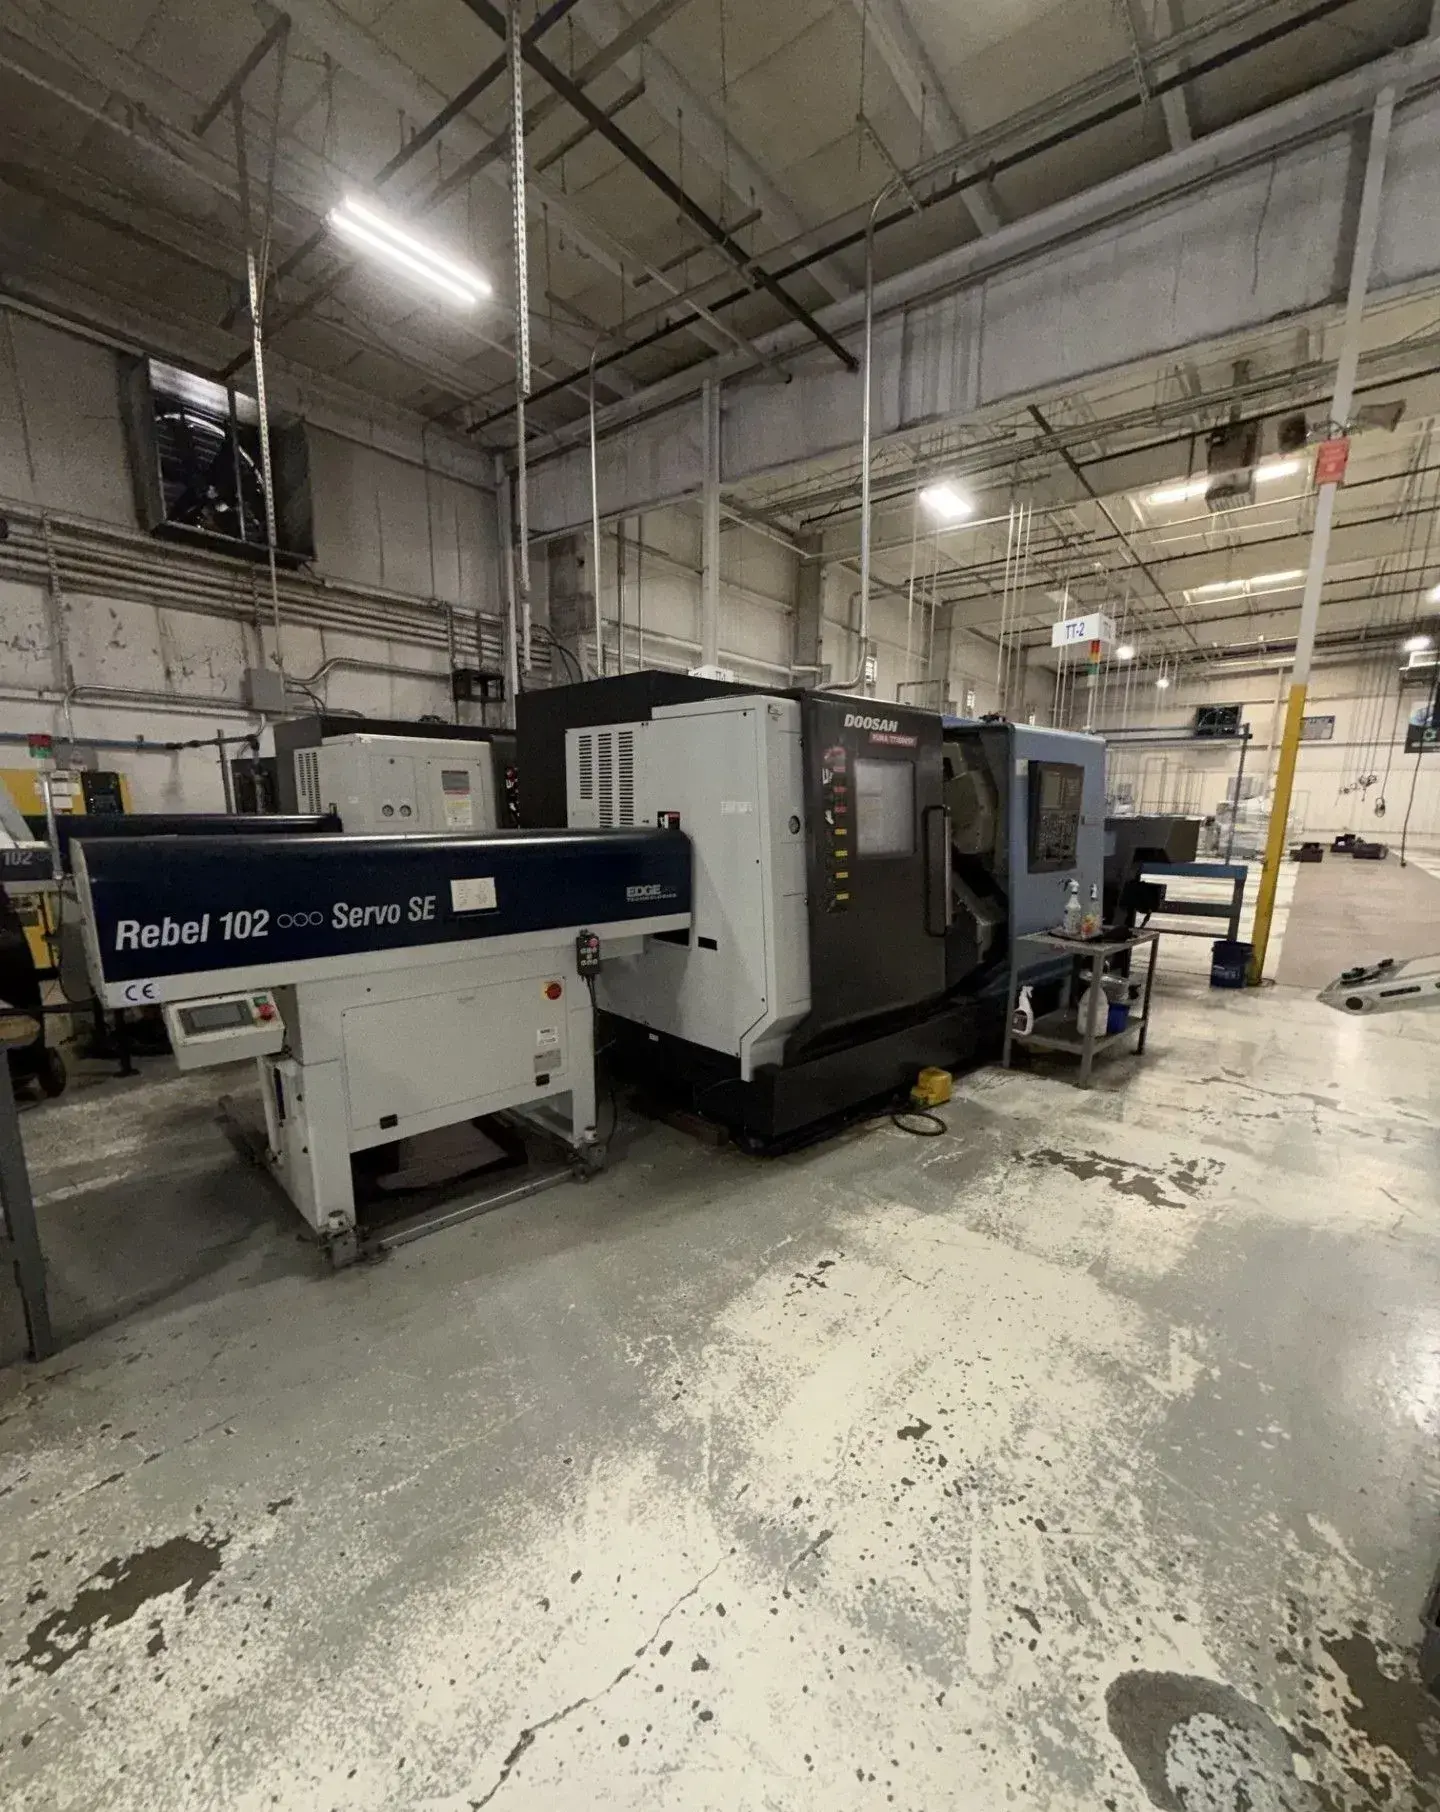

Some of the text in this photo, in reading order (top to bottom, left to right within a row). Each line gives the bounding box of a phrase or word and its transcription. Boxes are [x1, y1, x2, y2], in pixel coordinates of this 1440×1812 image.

[1066, 622, 1085, 640] TT-2
[844, 713, 899, 732] DOOSAN
[3, 851, 33, 866] 102
[626, 884, 661, 898] EDGE
[115, 895, 436, 951] Rebel 102 Servo SE
[125, 983, 155, 1001] CE
